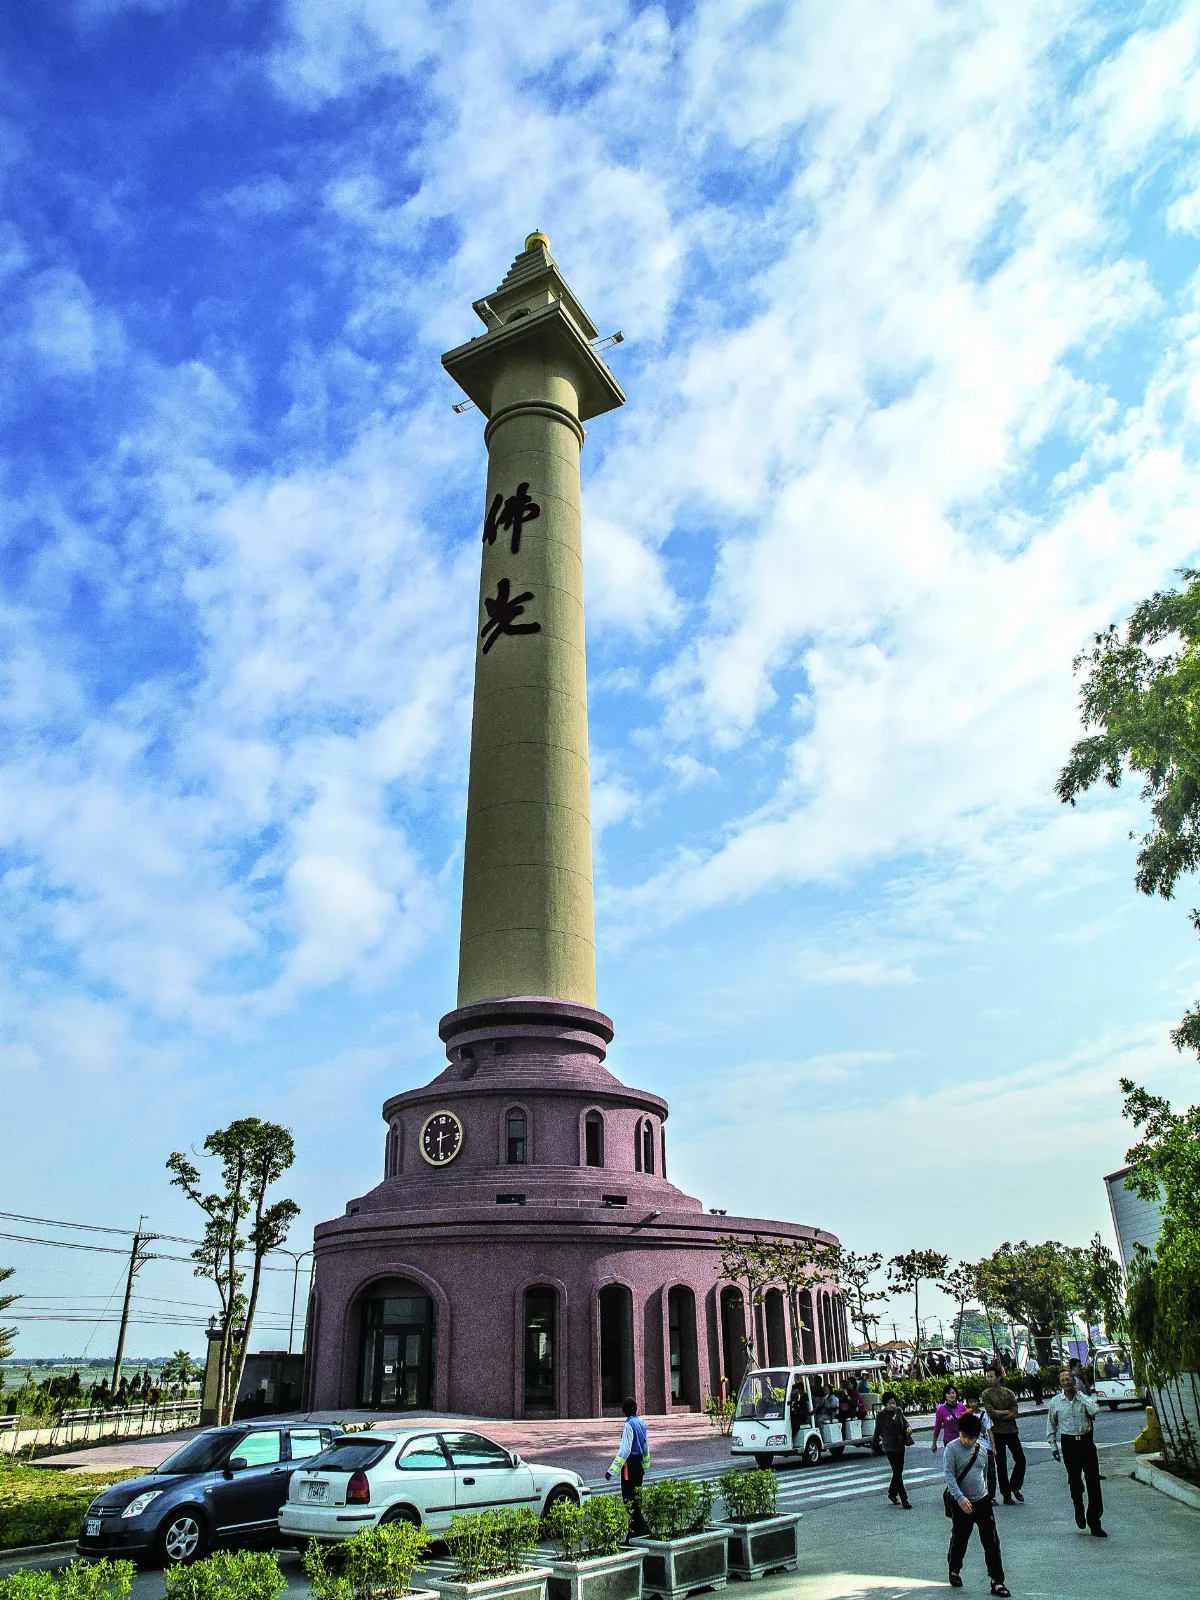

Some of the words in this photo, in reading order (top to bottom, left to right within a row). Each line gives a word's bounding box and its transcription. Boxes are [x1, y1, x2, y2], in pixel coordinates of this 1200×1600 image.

[481, 482, 541, 654] 佛光
[439, 1116, 446, 1124] 12
[454, 1132, 460, 1140] 3
[439, 1152, 444, 1160] 6
